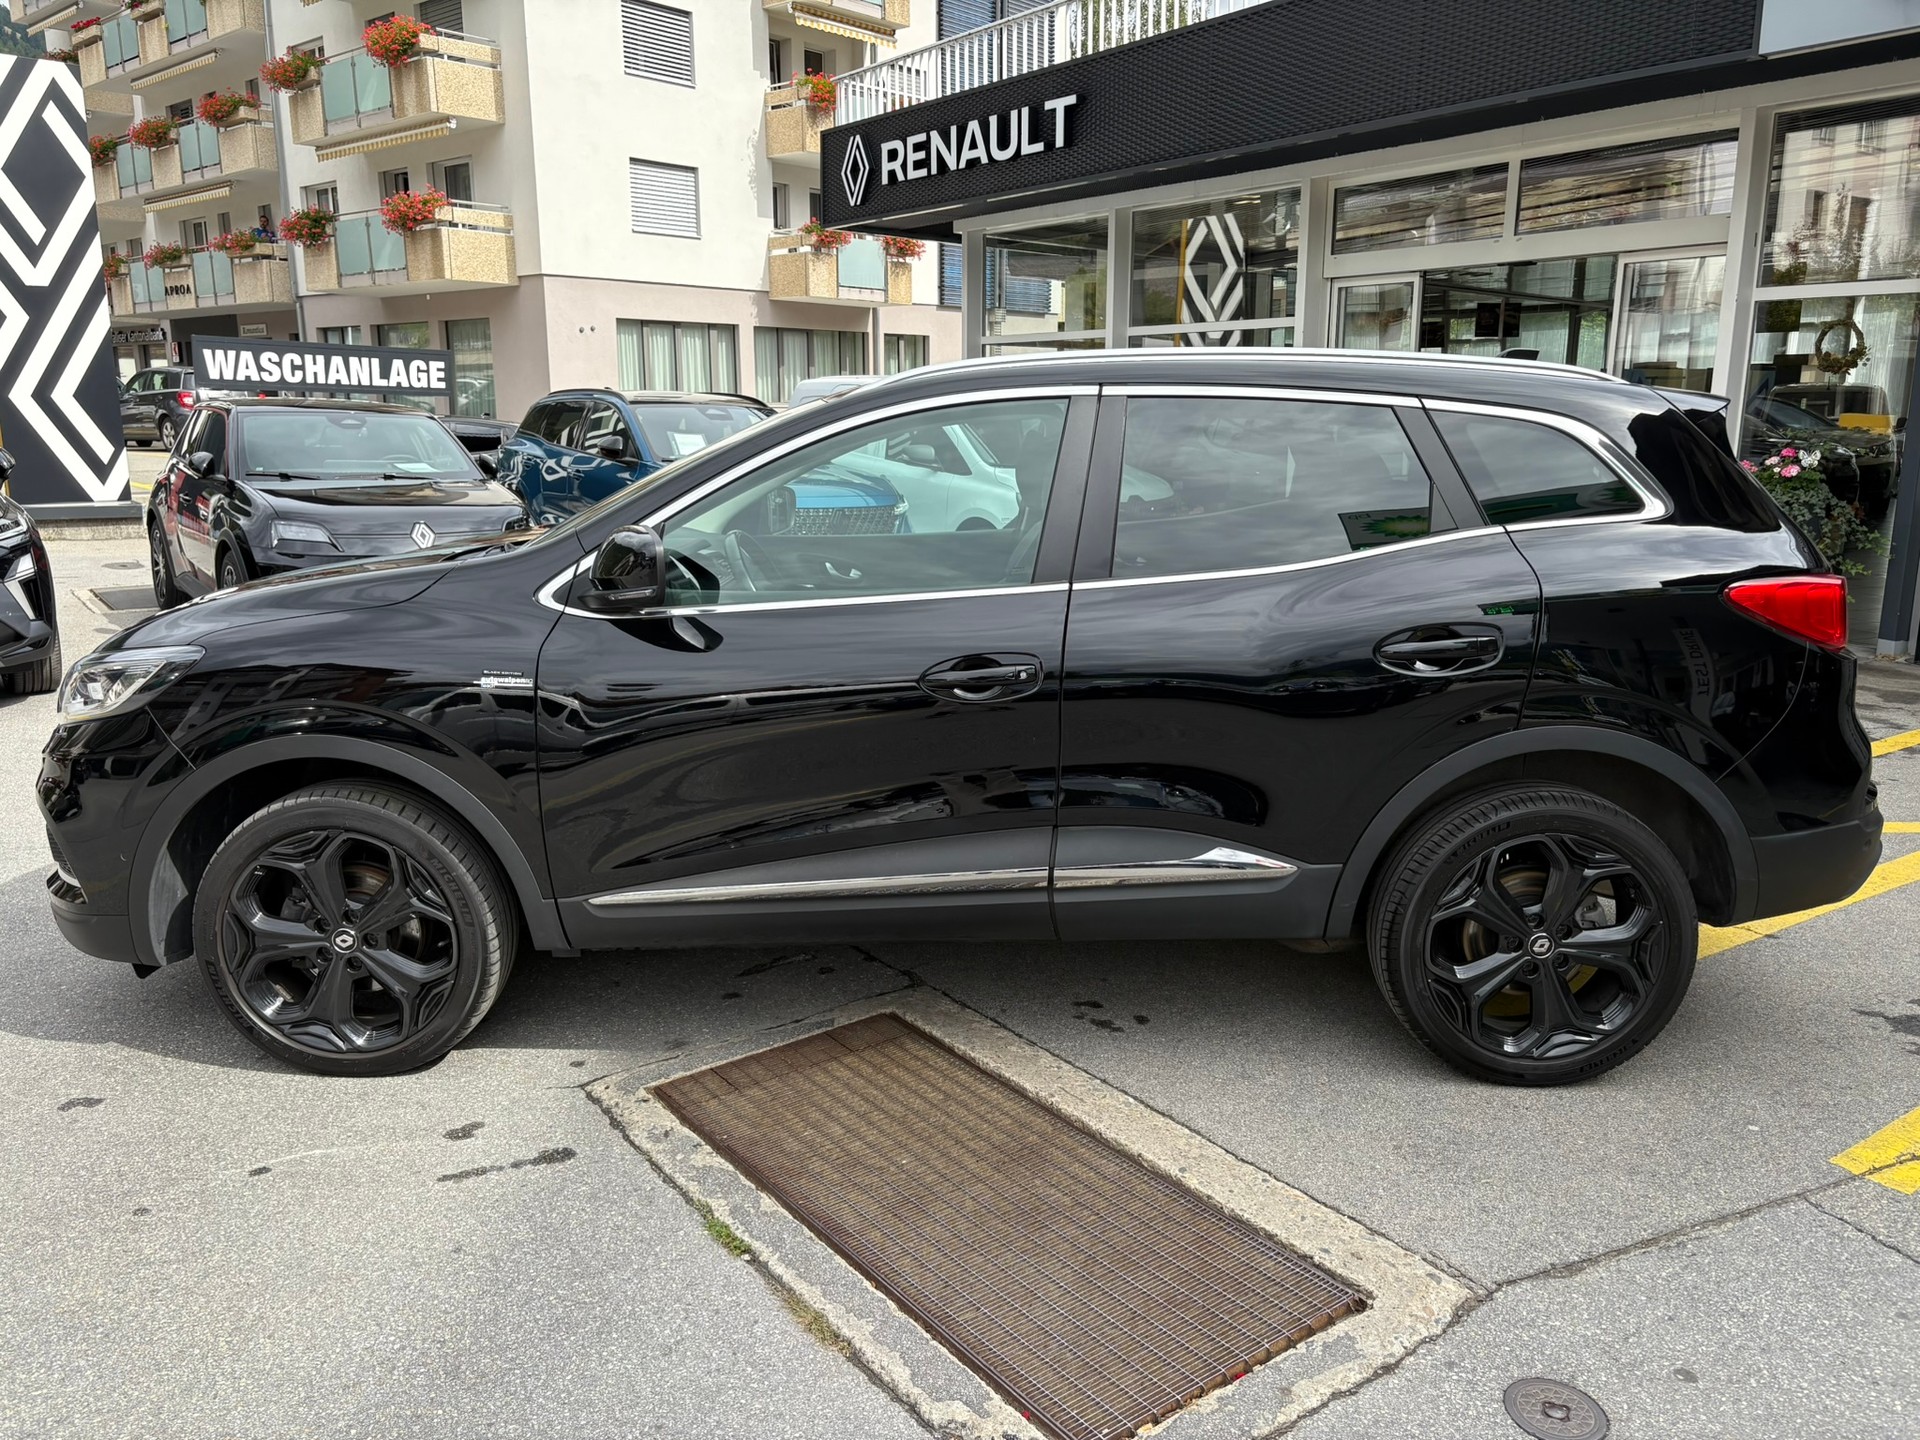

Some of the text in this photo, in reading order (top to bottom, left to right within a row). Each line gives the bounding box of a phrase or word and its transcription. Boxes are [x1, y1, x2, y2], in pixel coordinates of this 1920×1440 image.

[880, 94, 1077, 186] RENAULT
[164, 283, 192, 297] APROA
[202, 348, 446, 389] WASCHANLAGE
[430, 857, 475, 927] MICHELIN
